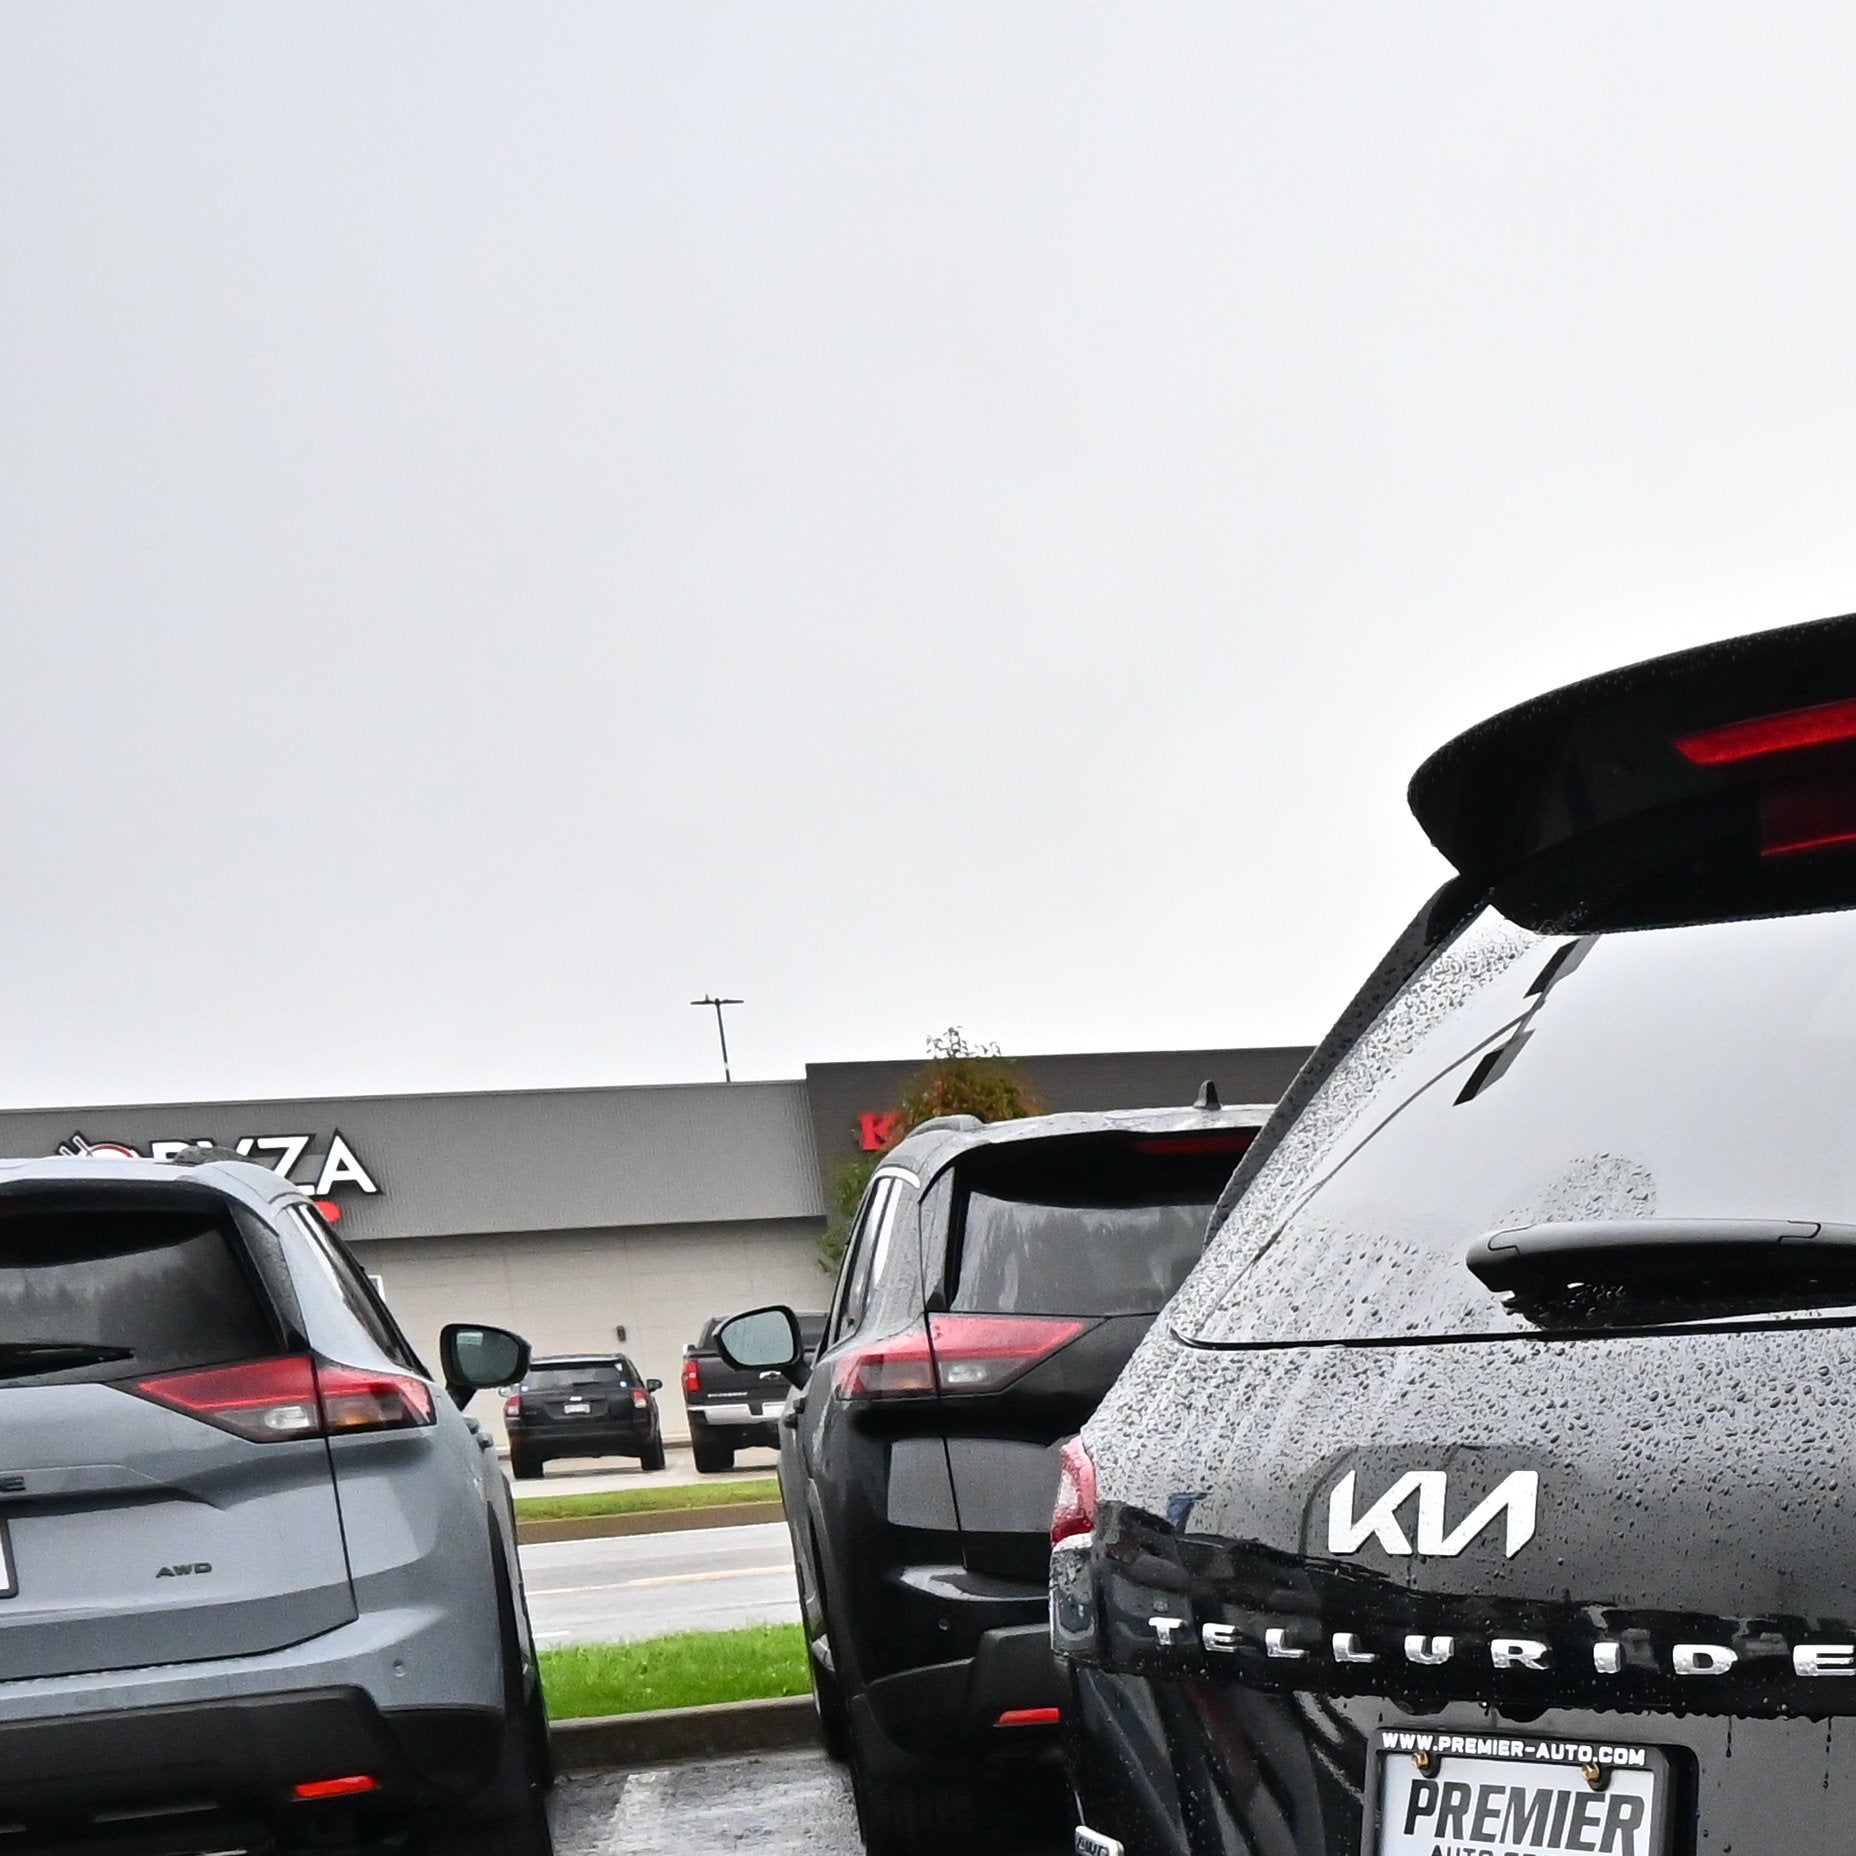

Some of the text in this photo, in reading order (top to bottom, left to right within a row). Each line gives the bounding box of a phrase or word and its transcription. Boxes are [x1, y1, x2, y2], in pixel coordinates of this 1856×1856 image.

[156, 1562, 212, 1578] AWD
[1381, 1732, 1645, 1766] WWW.PREMIER-AUTO.COM
[1403, 1778, 1646, 1854] PREMIER
